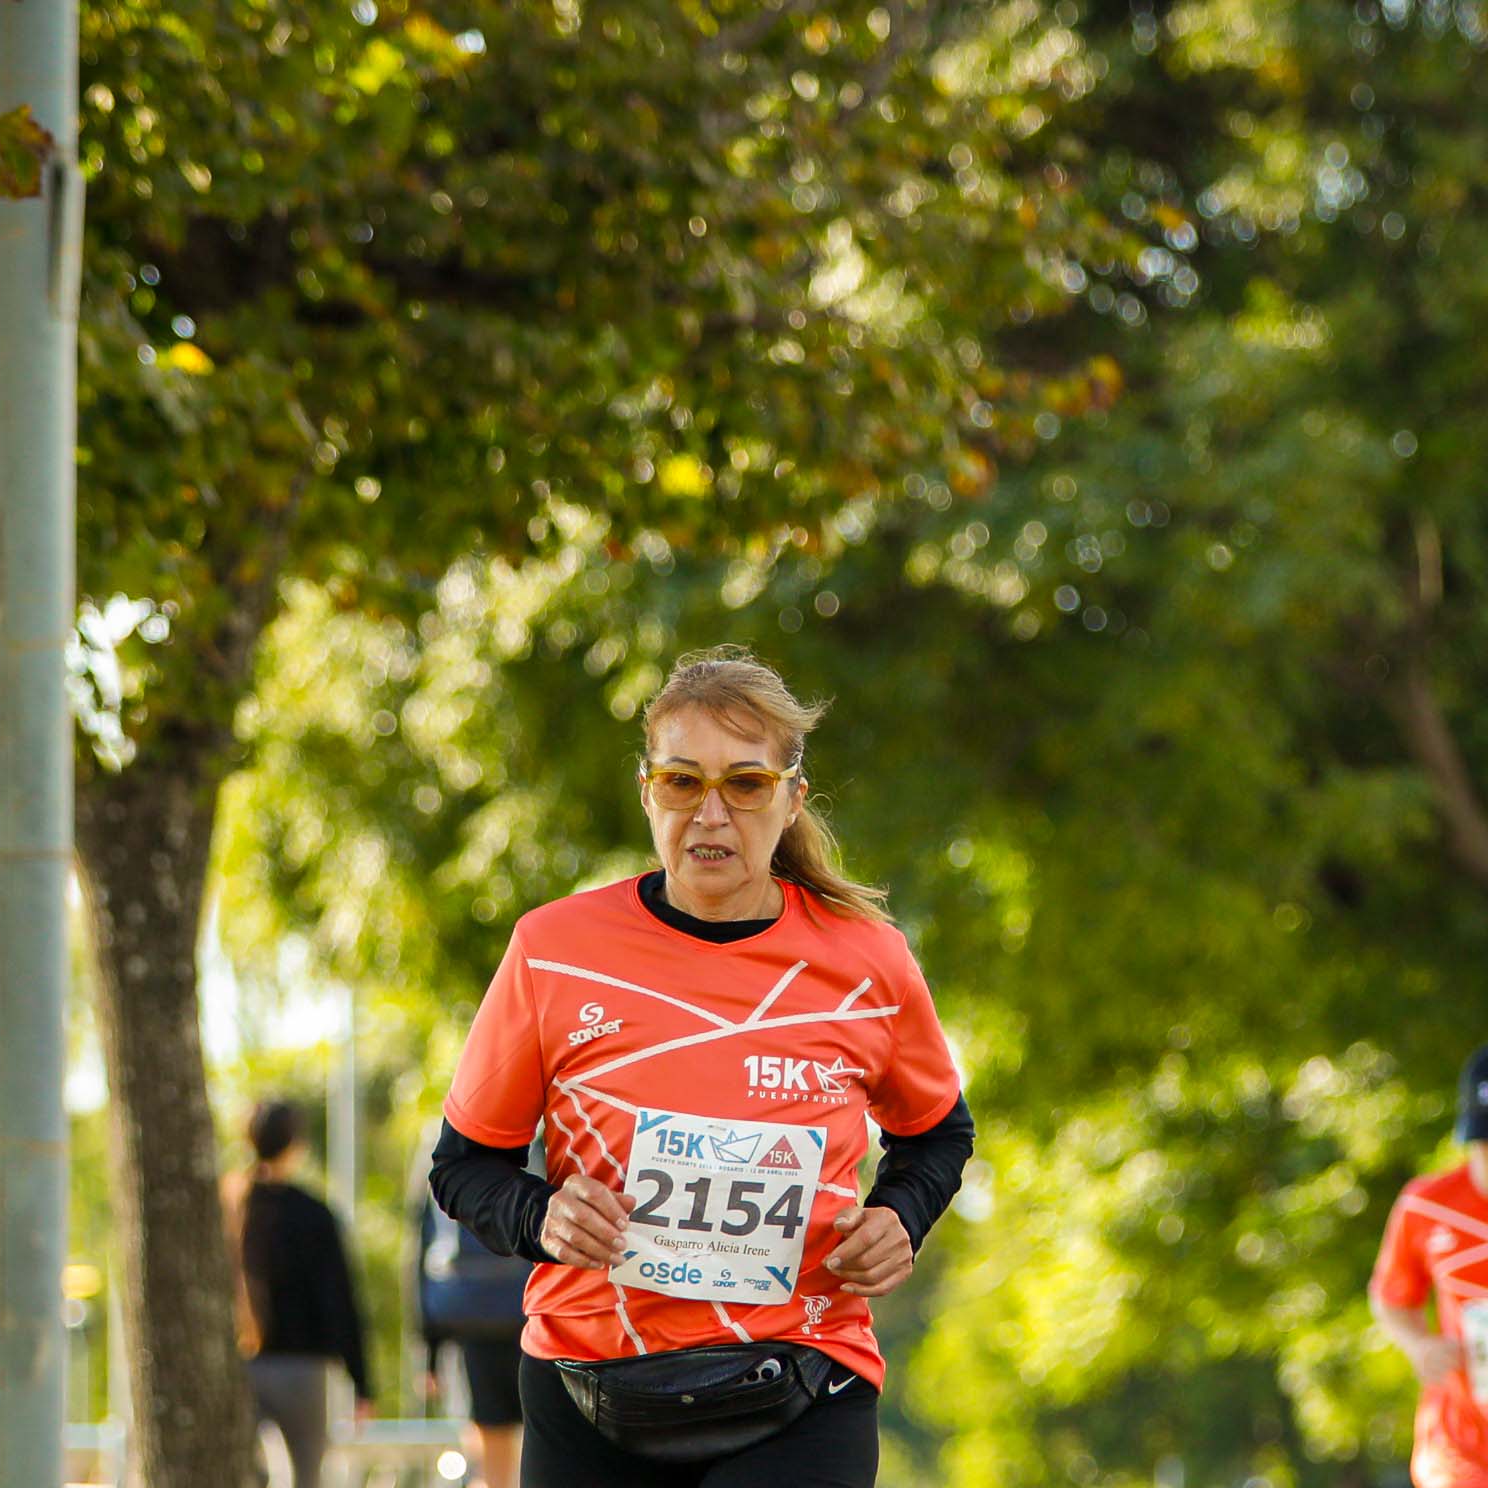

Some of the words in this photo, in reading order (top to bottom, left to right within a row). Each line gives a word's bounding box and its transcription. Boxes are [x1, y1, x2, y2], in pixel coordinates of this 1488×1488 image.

[743, 1055, 811, 1091] 15K
[655, 1128, 705, 1160] 15K
[768, 1150, 794, 1165] 15K
[629, 1168, 804, 1240] 2154
[654, 1234, 704, 1251] Gasparro
[706, 1241, 740, 1254] Alicia
[743, 1244, 771, 1257] Irene
[639, 1261, 702, 1284] osde
